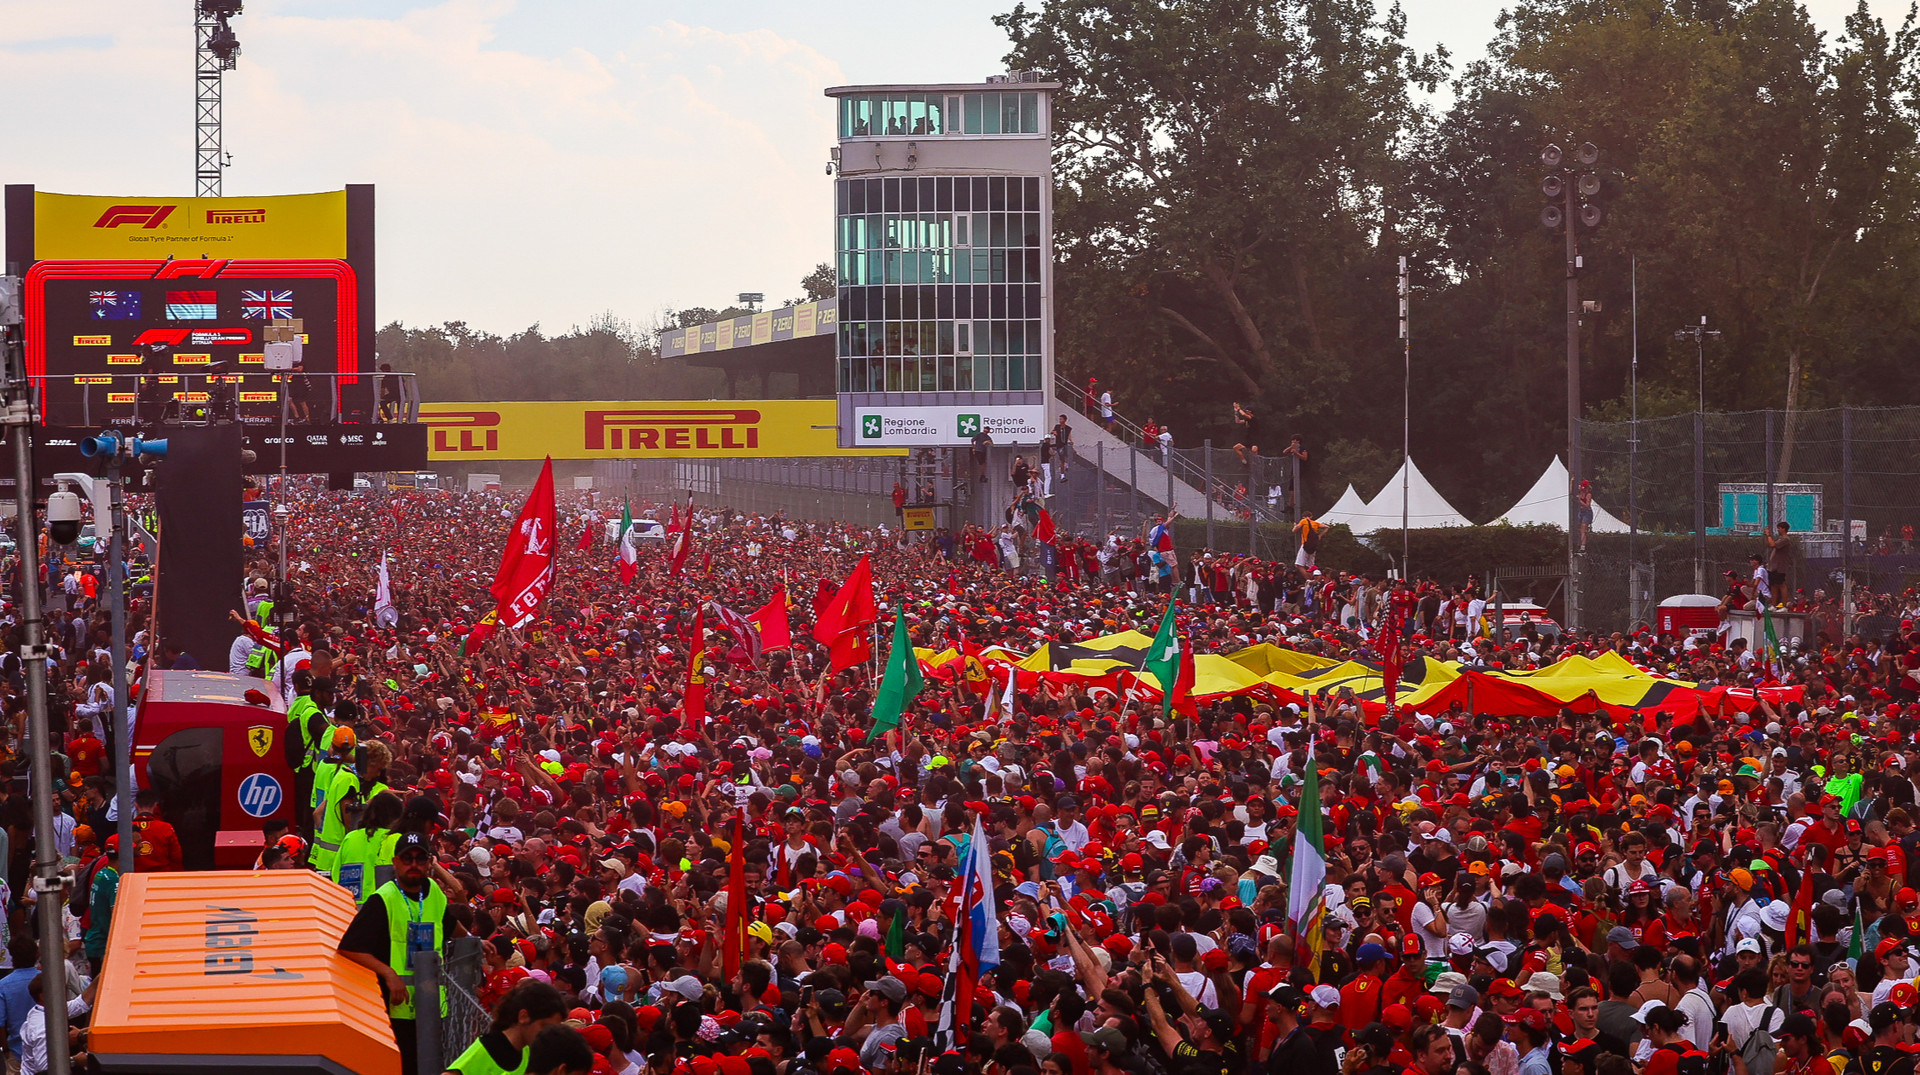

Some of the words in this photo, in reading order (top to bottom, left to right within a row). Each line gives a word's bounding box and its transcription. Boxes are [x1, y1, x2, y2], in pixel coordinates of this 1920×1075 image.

[93, 205, 177, 228] F1
[206, 209, 266, 224] PIRELLI
[884, 418, 925, 427] Regione
[983, 417, 1025, 426] Regione
[584, 410, 761, 450] PIRELLI
[884, 427, 937, 435] Lombardia
[989, 426, 1036, 434] ombardia
[244, 774, 277, 816] hp
